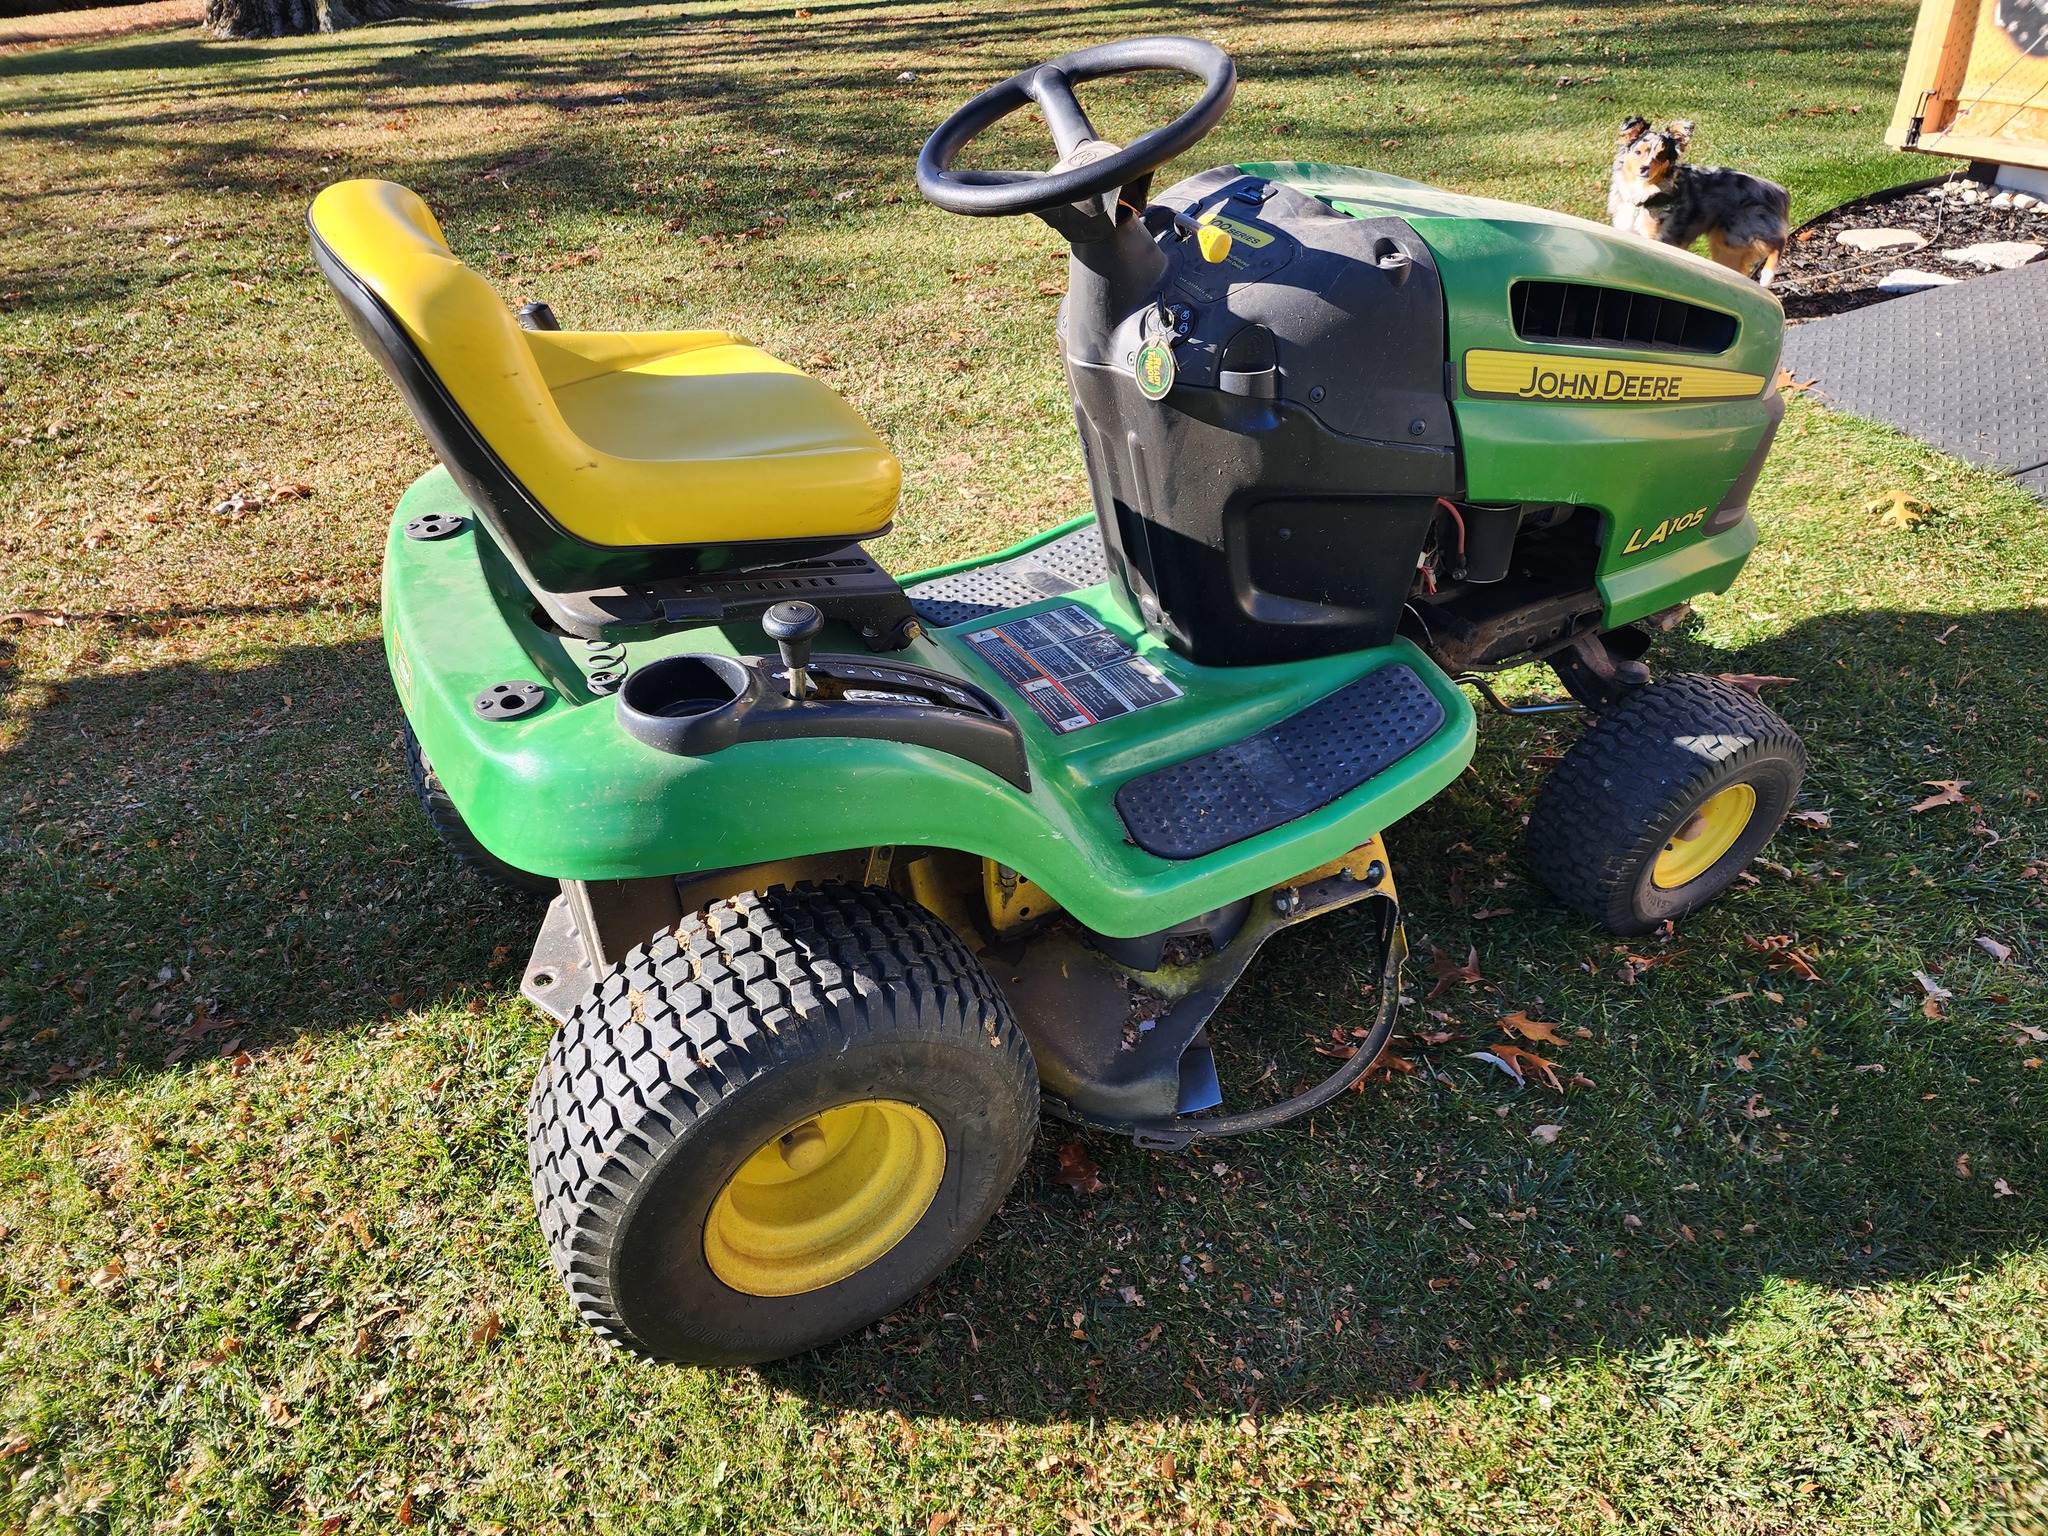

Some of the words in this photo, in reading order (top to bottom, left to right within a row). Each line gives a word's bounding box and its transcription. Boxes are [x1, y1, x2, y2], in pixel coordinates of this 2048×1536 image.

[1228, 228, 1261, 245] SERIES
[1153, 357, 1162, 387] READY
[1519, 366, 1599, 396] JOHN
[1603, 370, 1683, 398] DEERE
[1621, 504, 1709, 557] LA105
